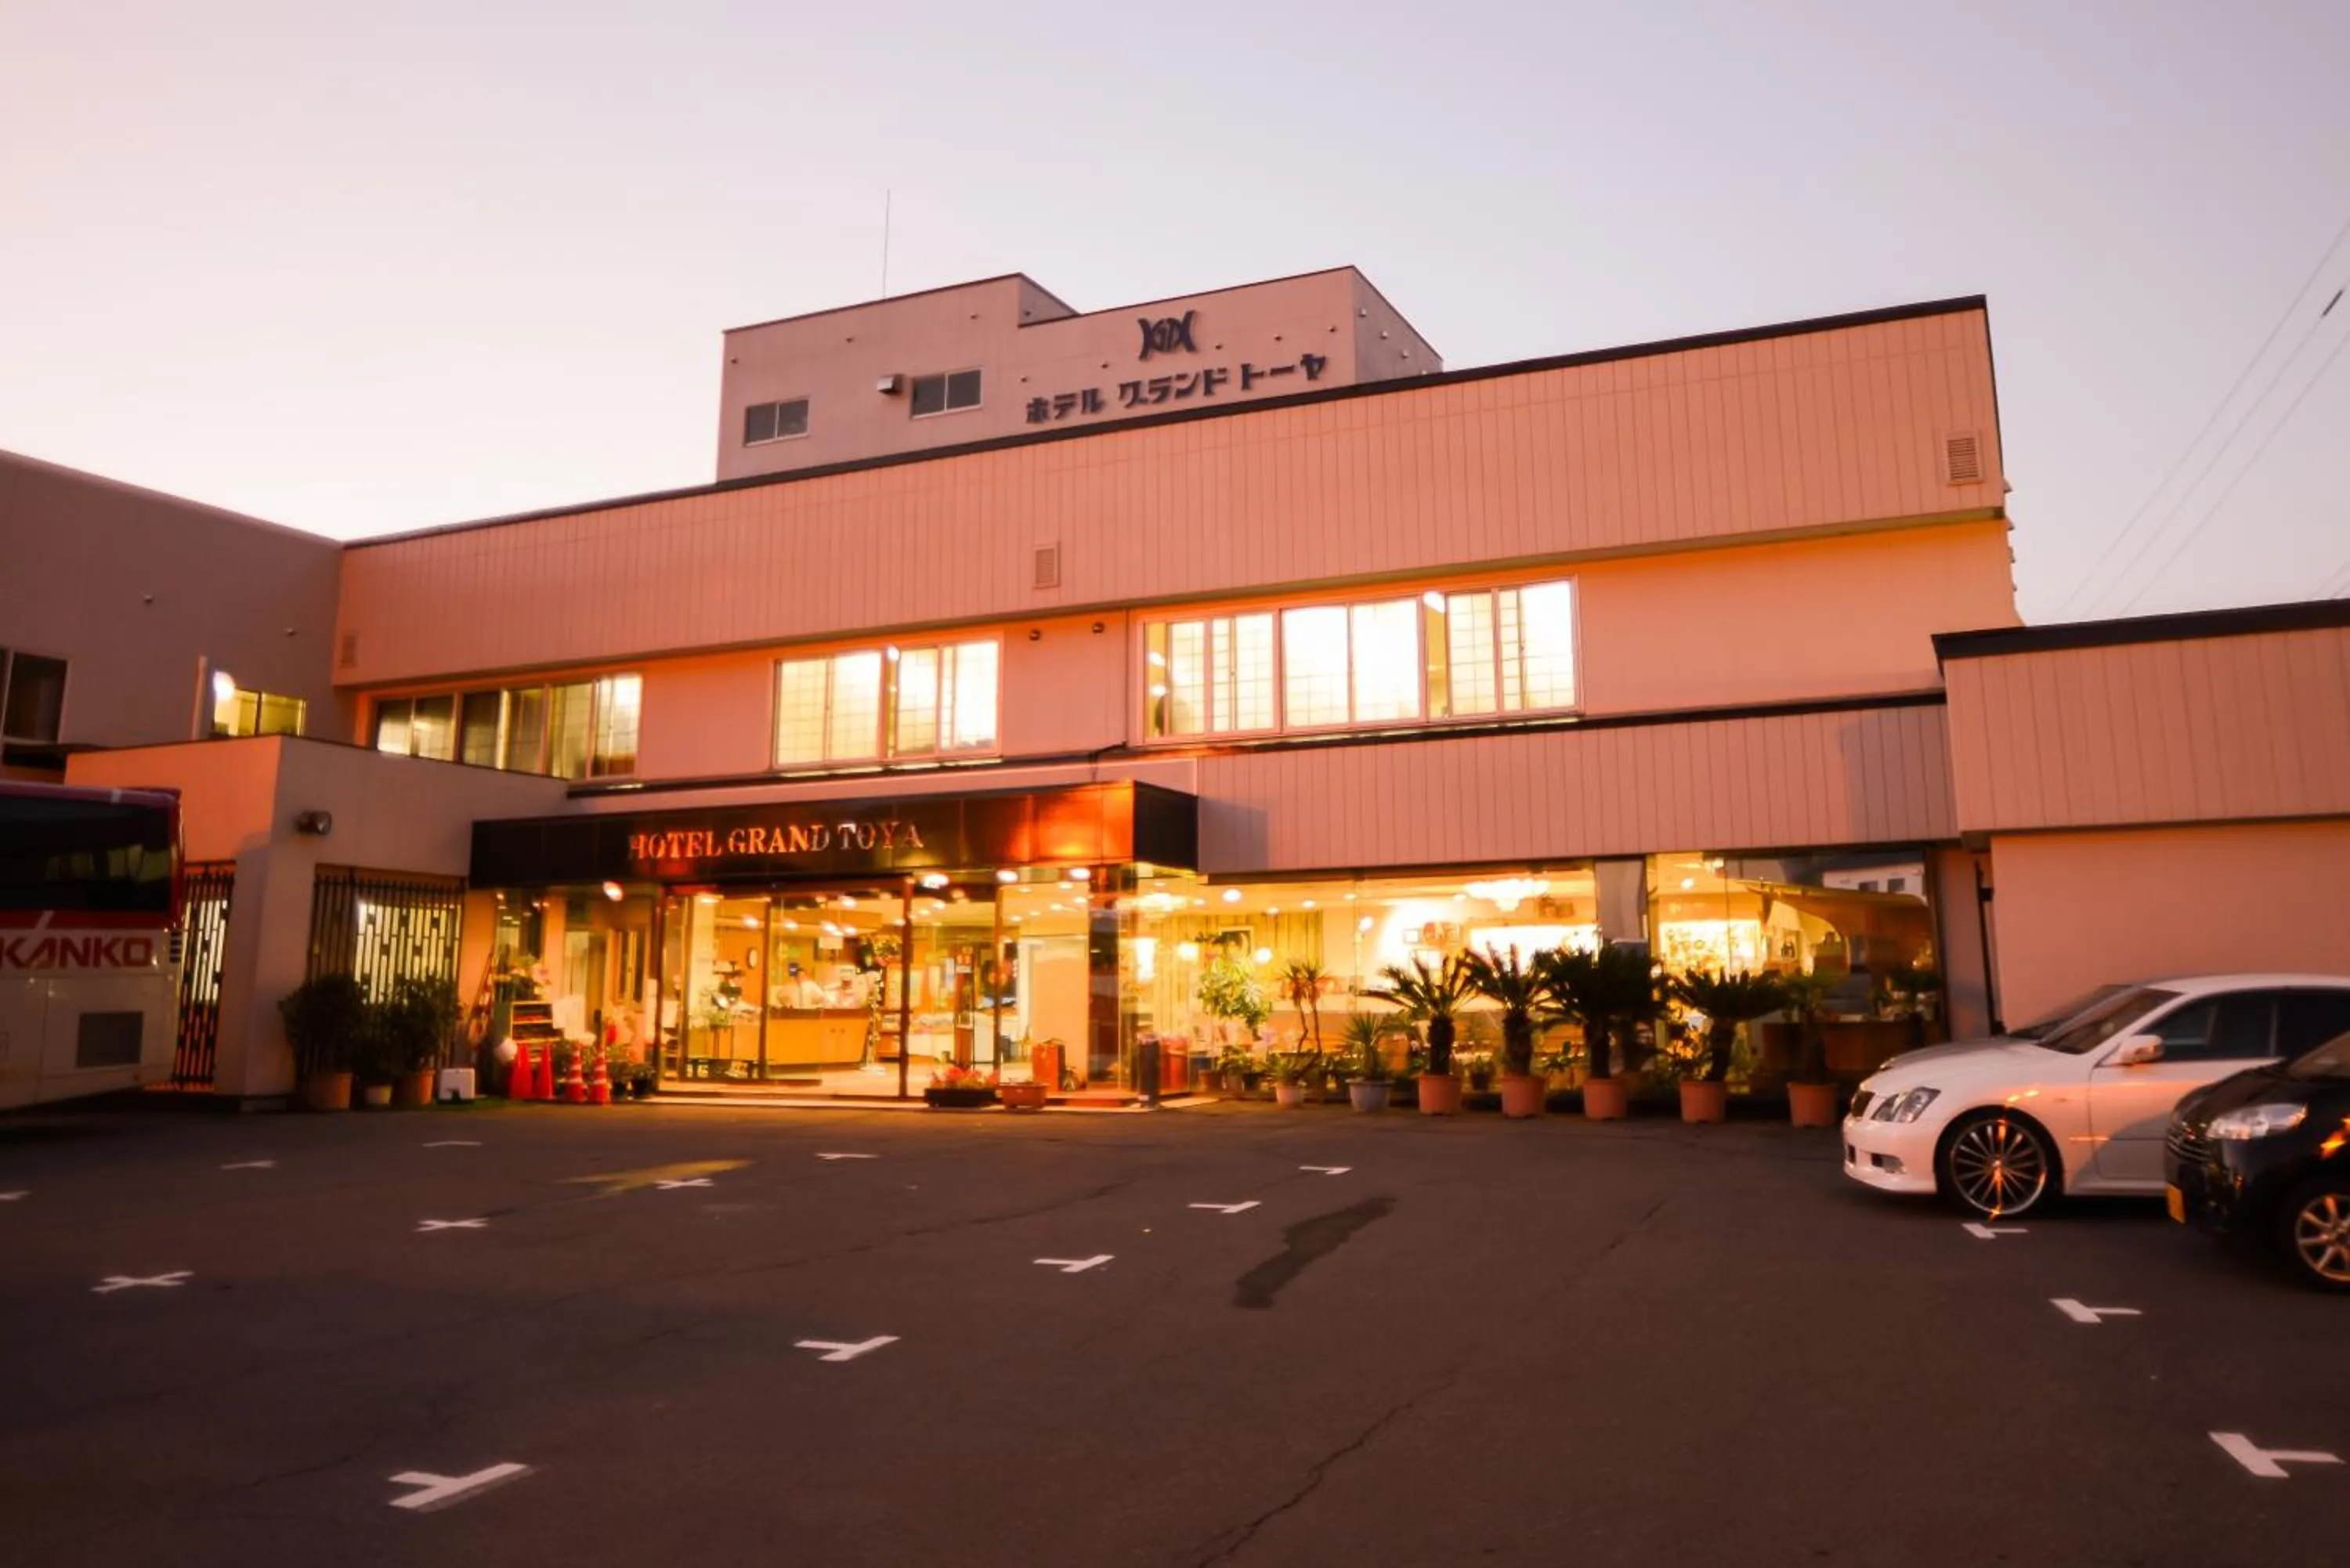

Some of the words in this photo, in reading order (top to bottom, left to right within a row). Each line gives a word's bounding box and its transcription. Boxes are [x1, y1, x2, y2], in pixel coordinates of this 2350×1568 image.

[1026, 388, 1104, 424] ホテル
[1240, 354, 1326, 390] トーヤ
[629, 831, 721, 859] HOTEL
[728, 825, 830, 854] GRAND
[836, 821, 924, 851] TOYA
[0, 937, 153, 969] KANKO
